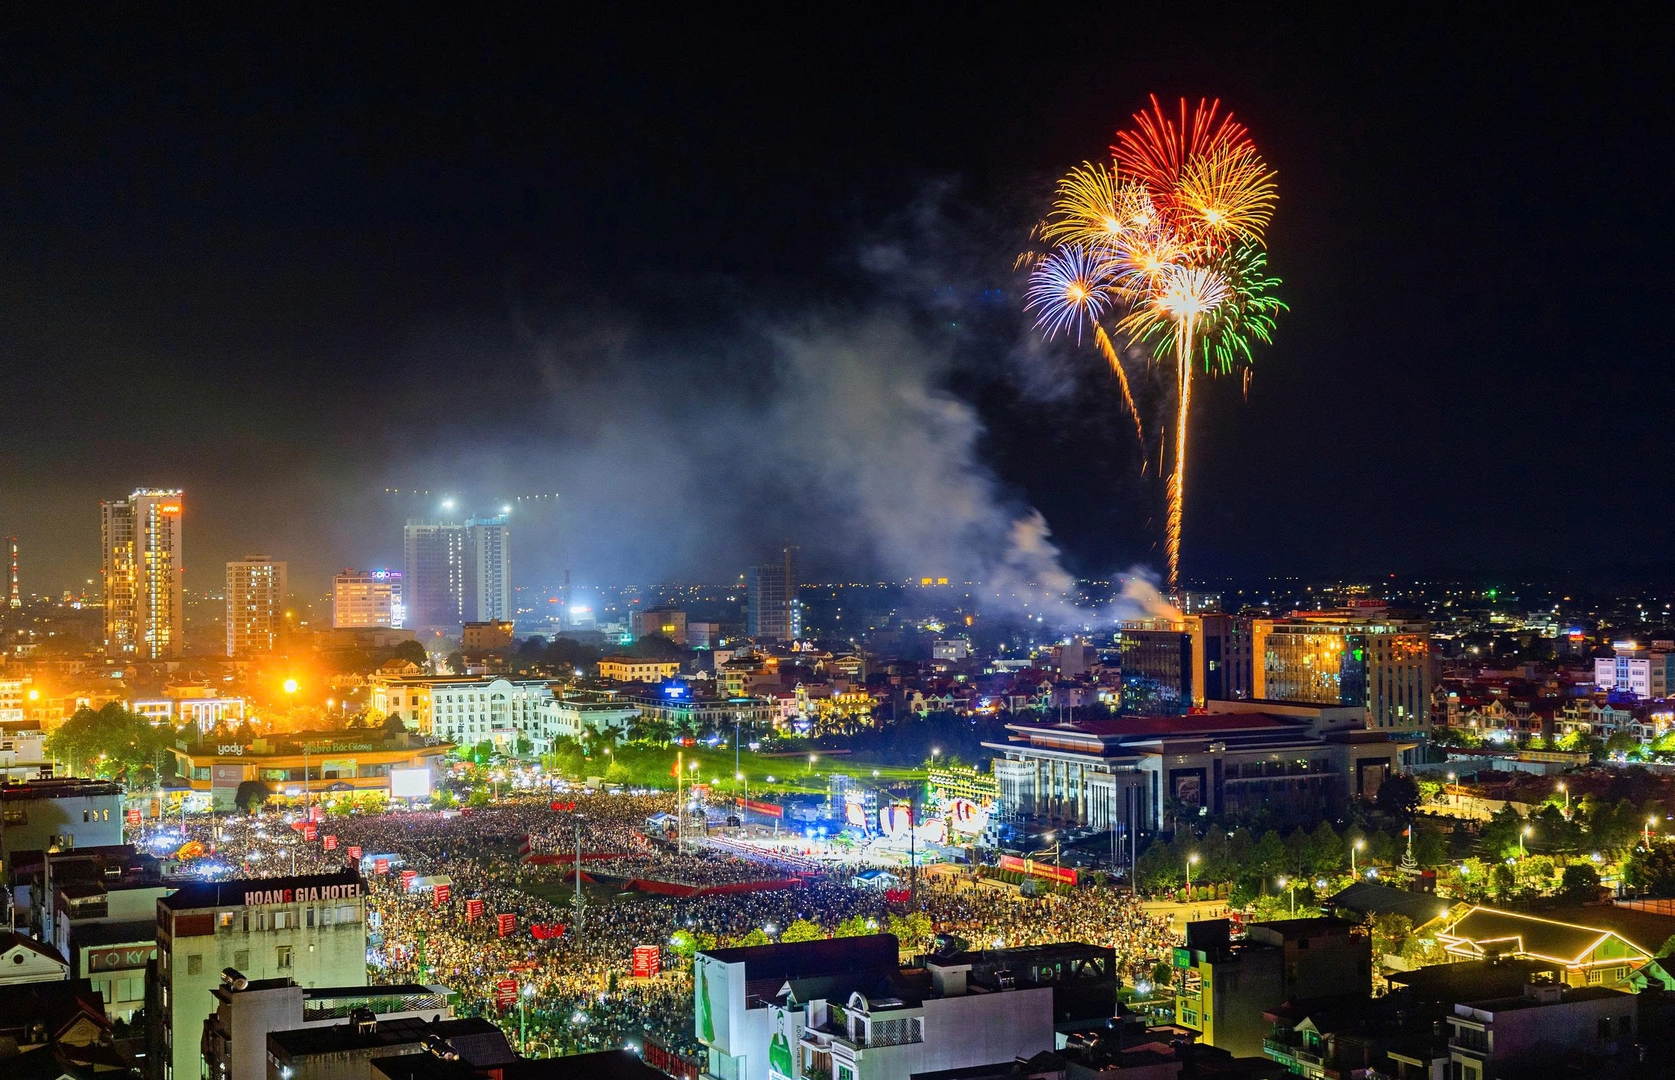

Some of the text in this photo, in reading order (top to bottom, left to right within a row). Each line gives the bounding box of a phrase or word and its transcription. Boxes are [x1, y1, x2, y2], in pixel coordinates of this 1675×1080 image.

[217, 742, 245, 755] yody
[245, 884, 363, 906] HOANG GIA HOTEL
